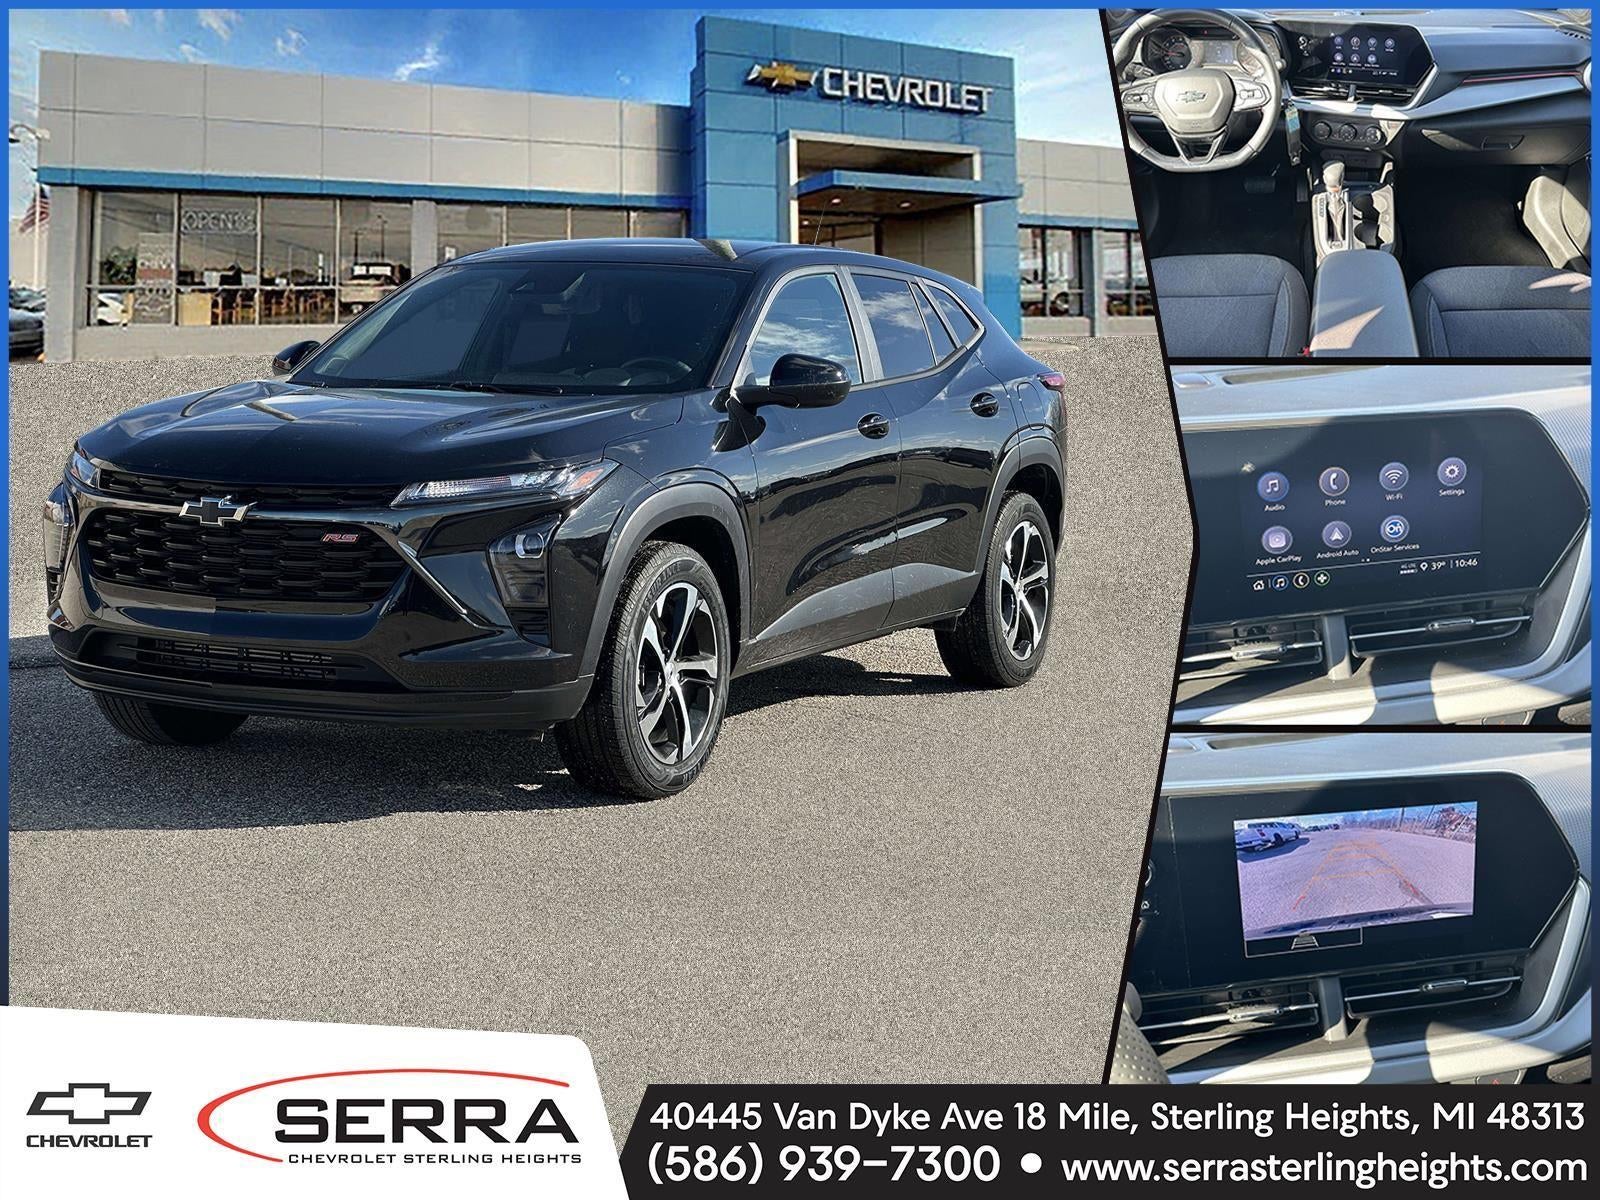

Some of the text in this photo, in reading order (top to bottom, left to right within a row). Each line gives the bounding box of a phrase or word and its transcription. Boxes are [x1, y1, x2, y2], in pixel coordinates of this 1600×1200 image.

[823, 66, 993, 113] CHEVROLET
[1385, 493, 1403, 501] Wi-Fi
[1439, 488, 1465, 497] Settings
[1324, 499, 1346, 507] Phone
[1264, 504, 1286, 512] Audio
[322, 533, 359, 542] RS
[1370, 543, 1420, 554] OnStar Services
[1316, 549, 1360, 559] Android Auto
[1255, 554, 1303, 566] Apple CarPlay
[1455, 558, 1478, 568] 10:46
